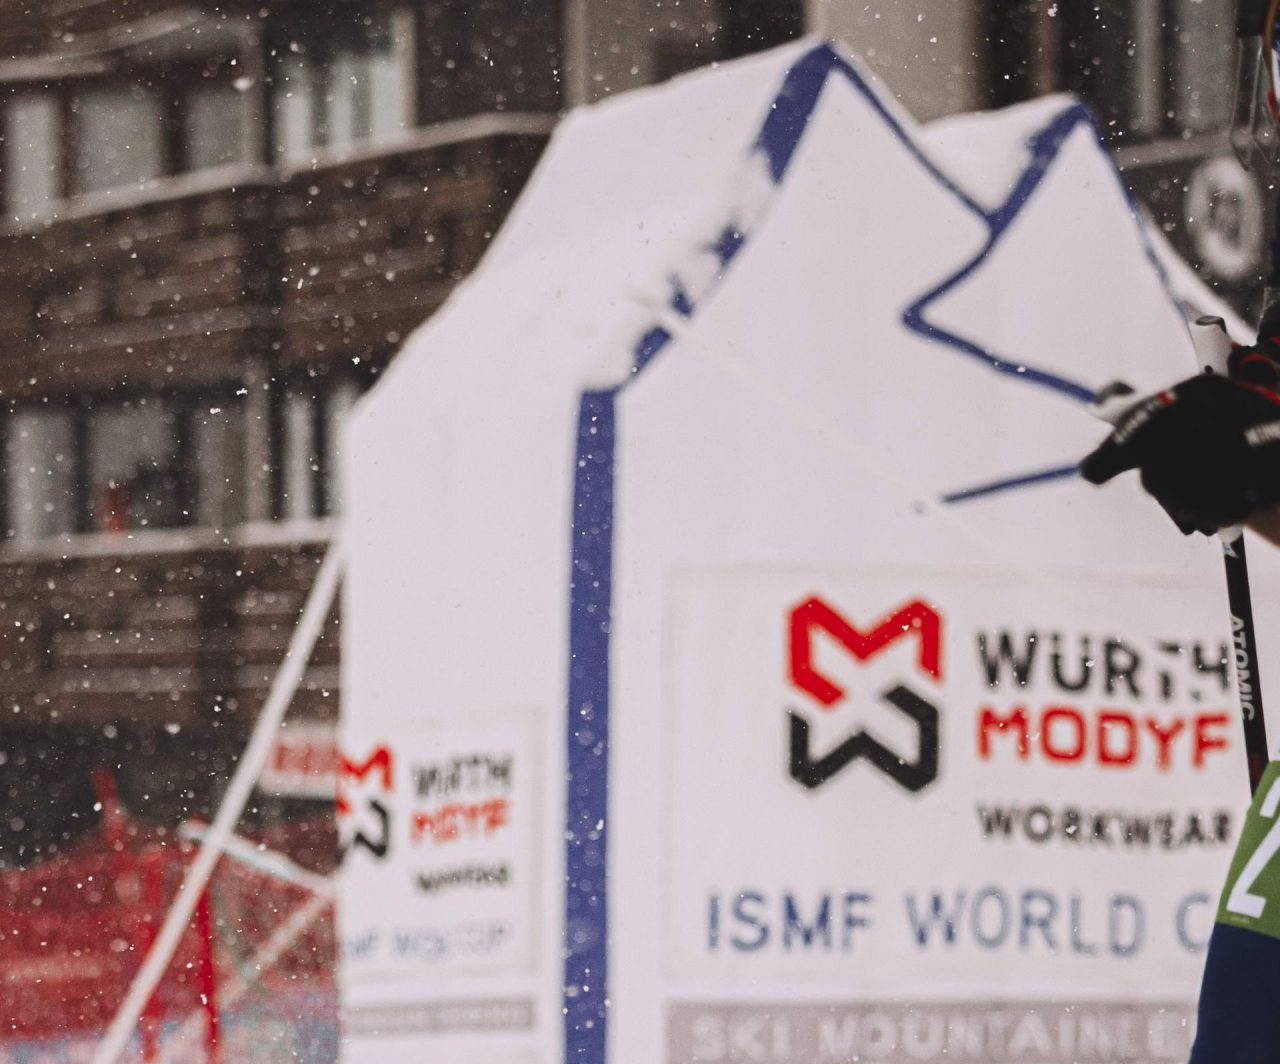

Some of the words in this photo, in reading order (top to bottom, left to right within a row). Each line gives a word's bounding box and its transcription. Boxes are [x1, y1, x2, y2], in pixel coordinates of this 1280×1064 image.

[978, 705, 1230, 772] MODYF
[708, 889, 872, 954] ISMF
[905, 886, 1147, 958] WORLD
[692, 1011, 793, 1060] SKI
